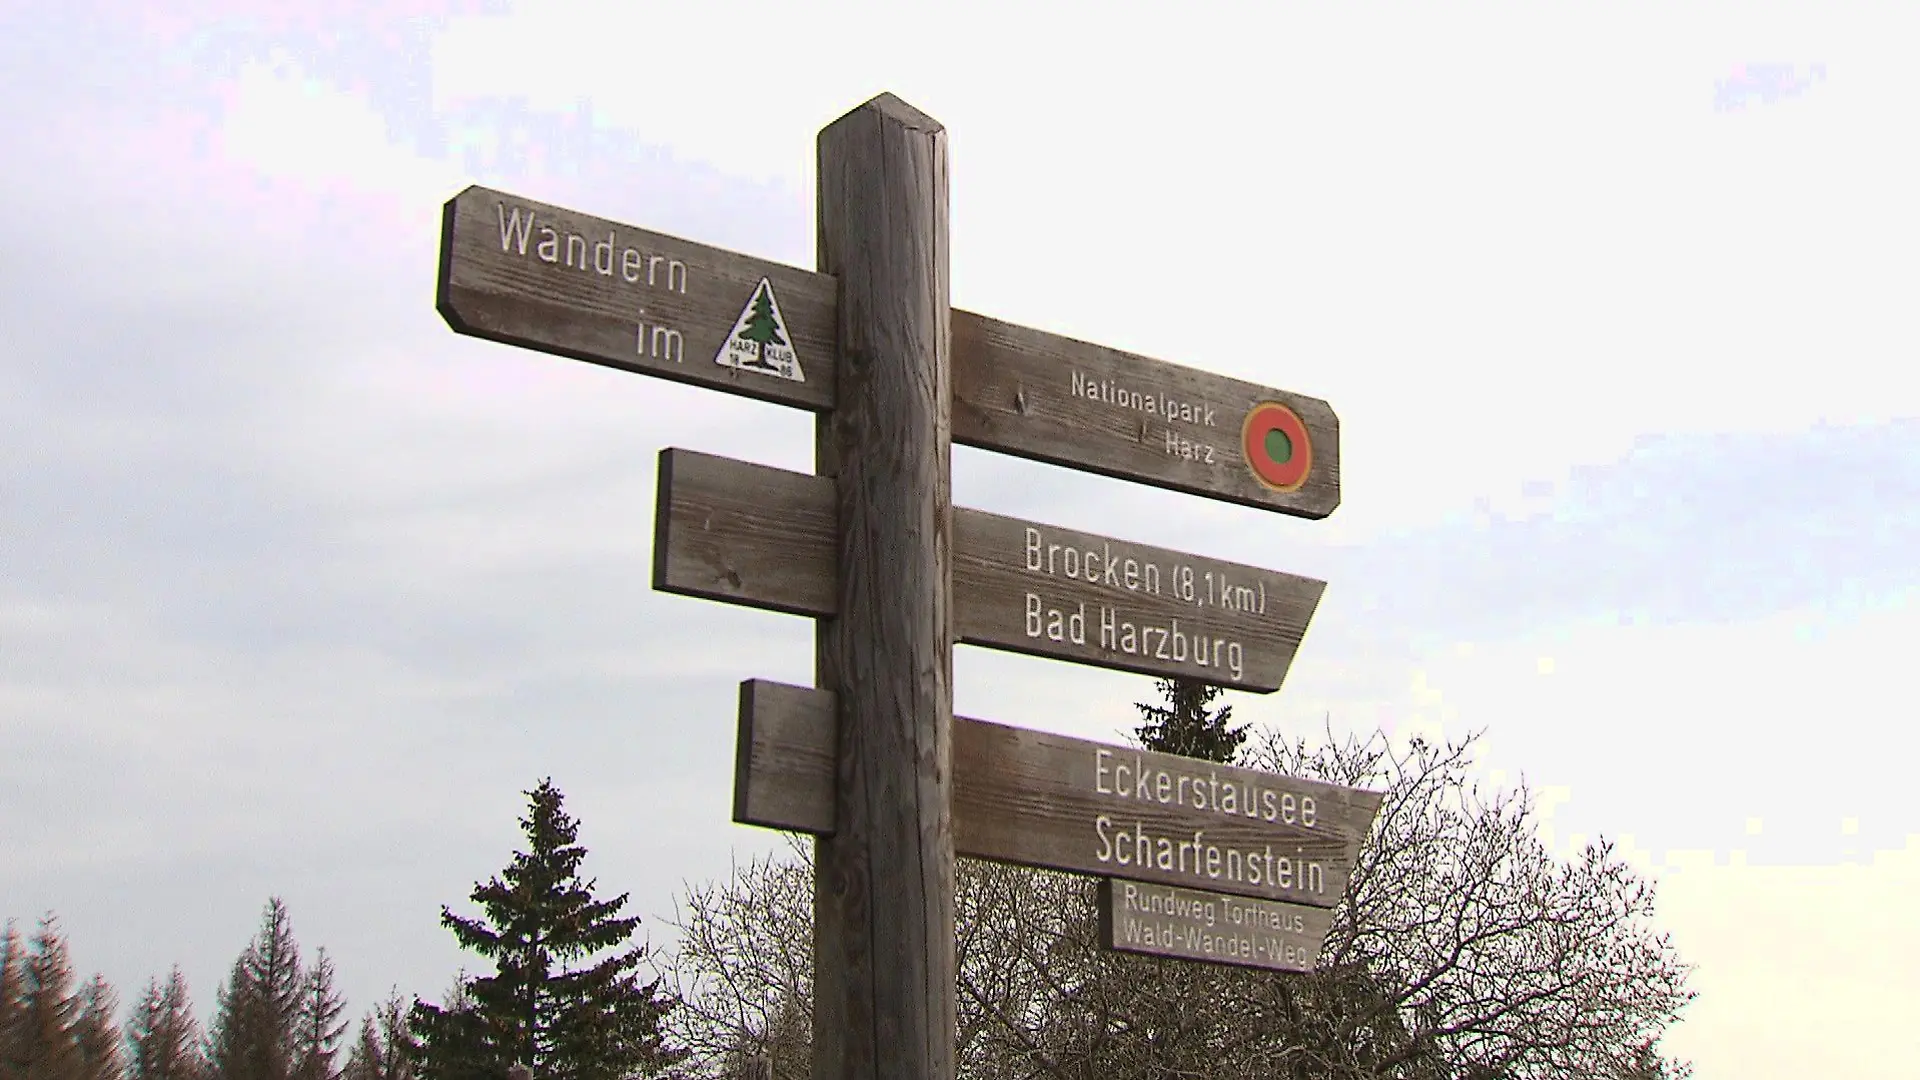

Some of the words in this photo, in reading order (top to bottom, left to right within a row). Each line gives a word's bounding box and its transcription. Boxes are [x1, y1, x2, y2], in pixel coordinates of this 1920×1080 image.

[497, 201, 688, 295] Wandern
[636, 308, 686, 364] im
[729, 340, 757, 355] HARZ
[767, 347, 792, 363] KLUB
[1071, 370, 1216, 427] Nationalpark
[1165, 430, 1215, 464] Harz
[1025, 527, 1160, 595] Brocken
[1025, 592, 1086, 645] Bad
[1100, 606, 1244, 681] Harzburg
[1095, 748, 1318, 828] Eckerstausee
[1095, 815, 1324, 895] Scharfenstein
[1123, 884, 1215, 926] Rundweg
[1221, 898, 1304, 934] Torfhaus
[1123, 918, 1307, 968] Wald-Wandel-Weg
